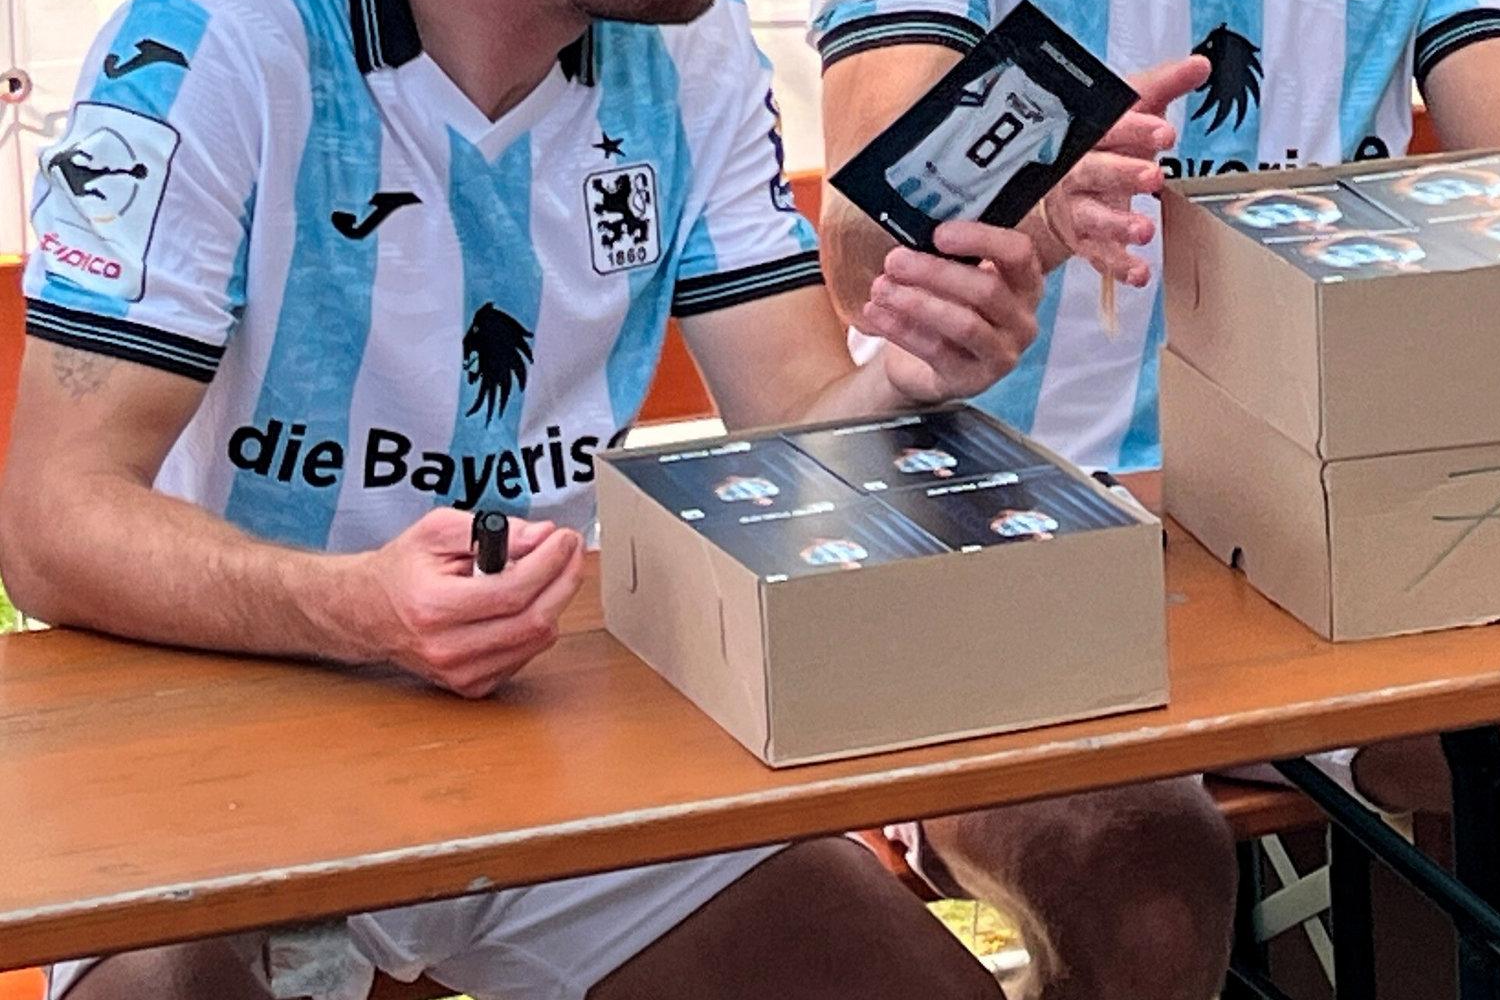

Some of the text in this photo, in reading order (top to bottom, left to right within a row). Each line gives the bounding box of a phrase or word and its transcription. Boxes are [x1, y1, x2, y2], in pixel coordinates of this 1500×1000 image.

[966, 112, 1024, 168] 8
[228, 418, 629, 509] die Bayeris
